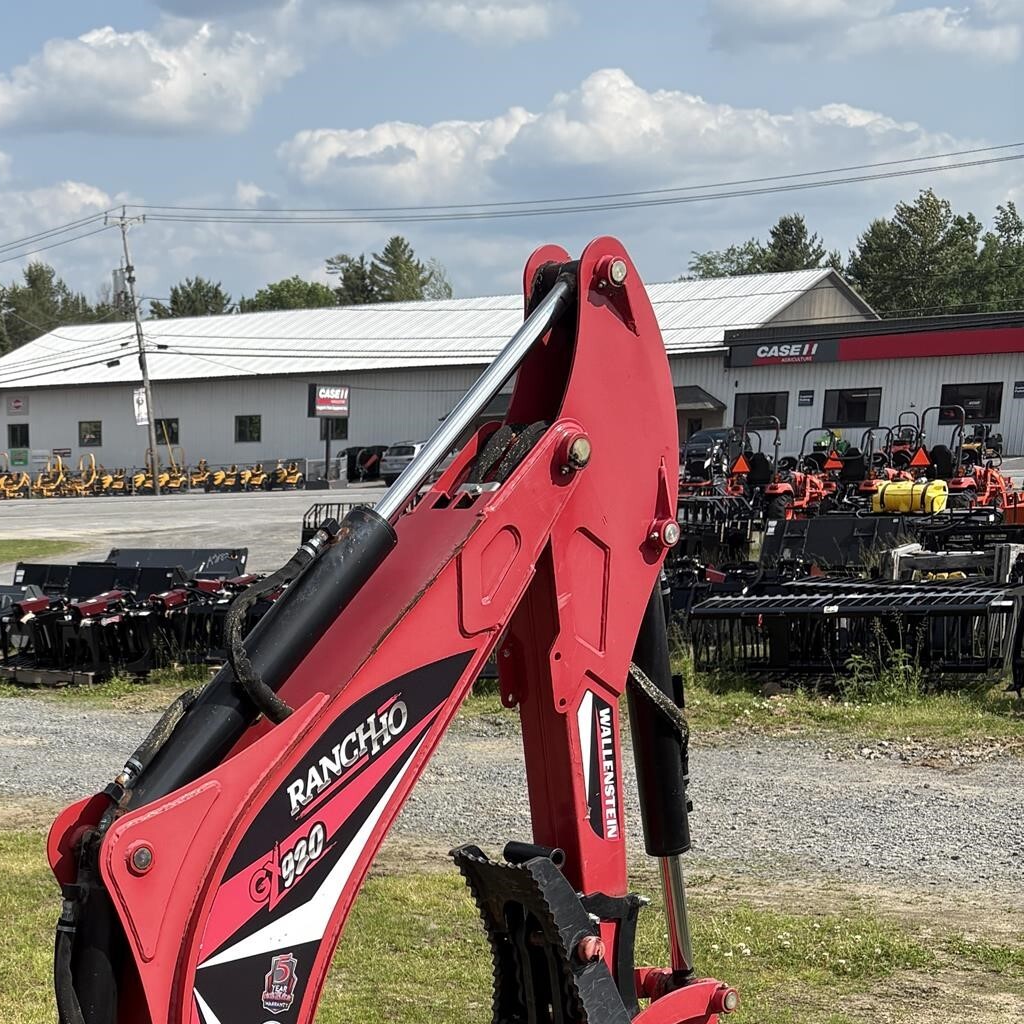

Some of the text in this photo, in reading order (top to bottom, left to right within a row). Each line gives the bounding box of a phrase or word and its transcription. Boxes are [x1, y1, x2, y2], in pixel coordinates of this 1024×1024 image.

[757, 344, 802, 357] CASE
[319, 387, 341, 399] CASE
[599, 707, 618, 838] WALLENSTEIN
[273, 953, 293, 984] 5
[271, 984, 288, 994] YEAR
